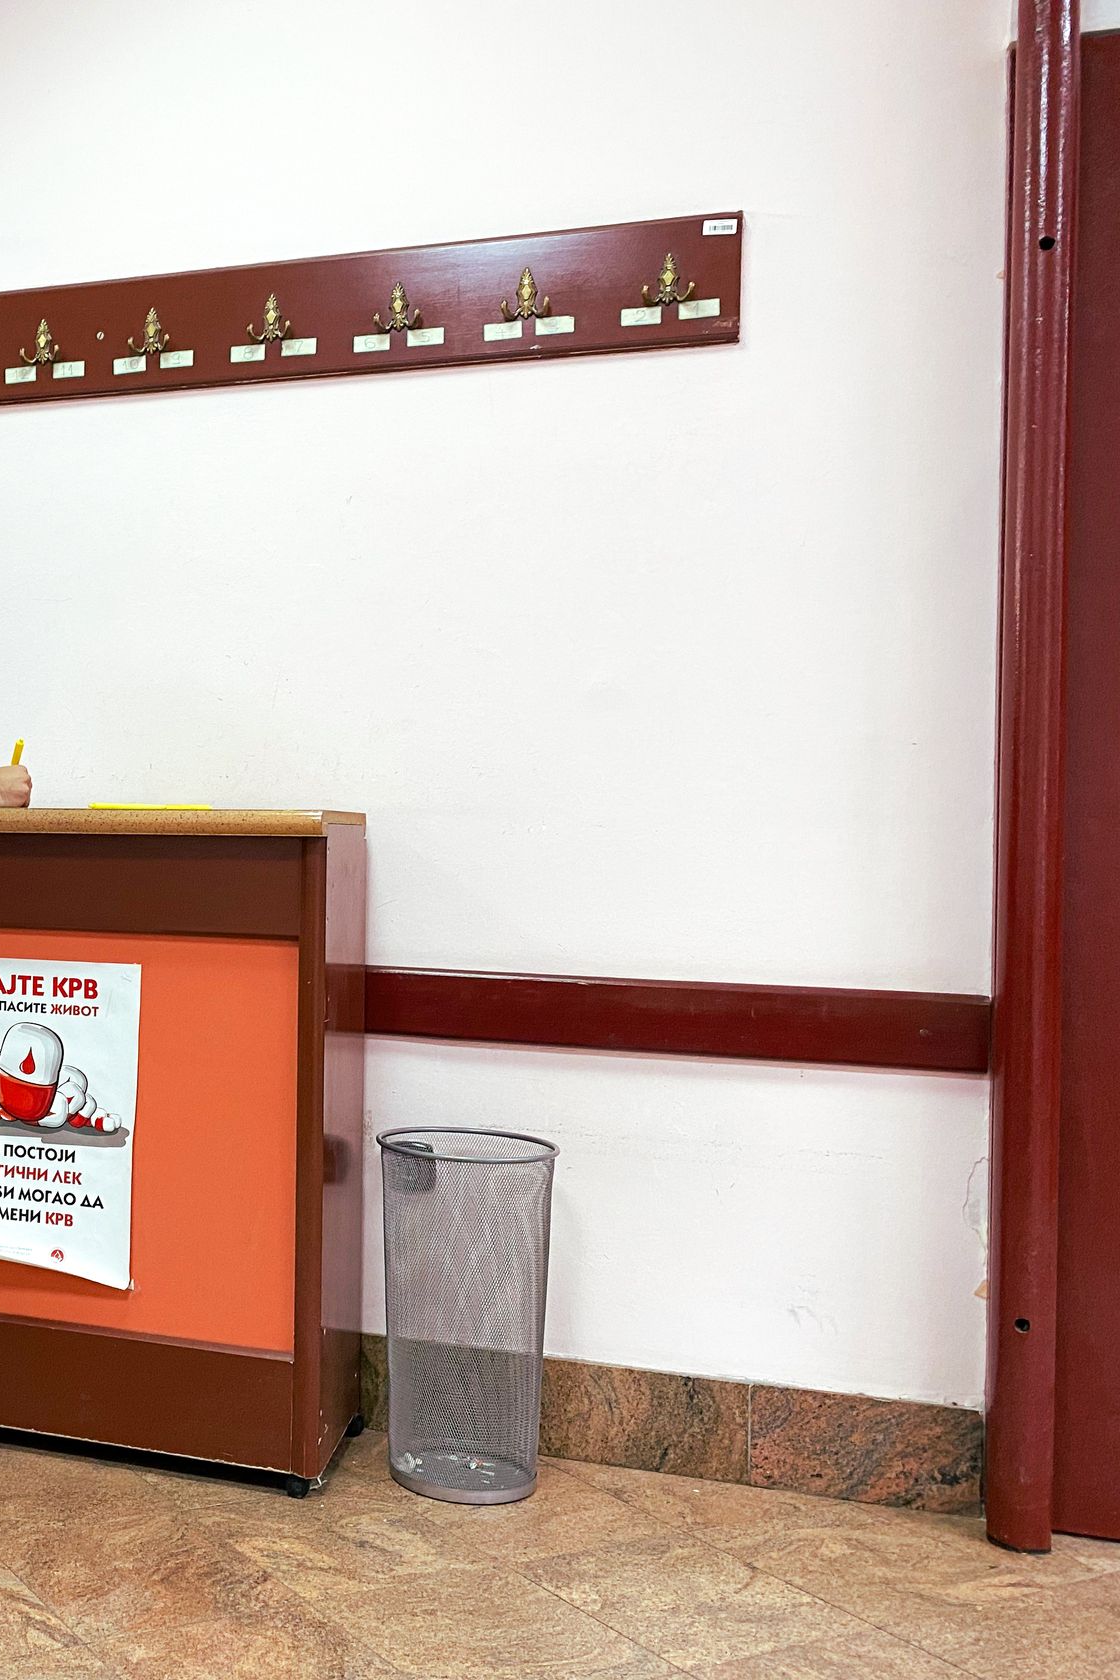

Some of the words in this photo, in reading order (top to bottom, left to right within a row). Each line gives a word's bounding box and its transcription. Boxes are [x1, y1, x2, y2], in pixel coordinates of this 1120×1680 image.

[53, 977, 98, 999] КРВ
[51, 1004, 99, 1016] ЖИВОТ
[3, 1145, 76, 1163] ПОСТОЈИ
[52, 1171, 82, 1185] ЛЕК
[18, 1188, 76, 1205] МОГАО
[80, 1194, 104, 1209] ДА
[45, 1212, 73, 1227] КРВ
